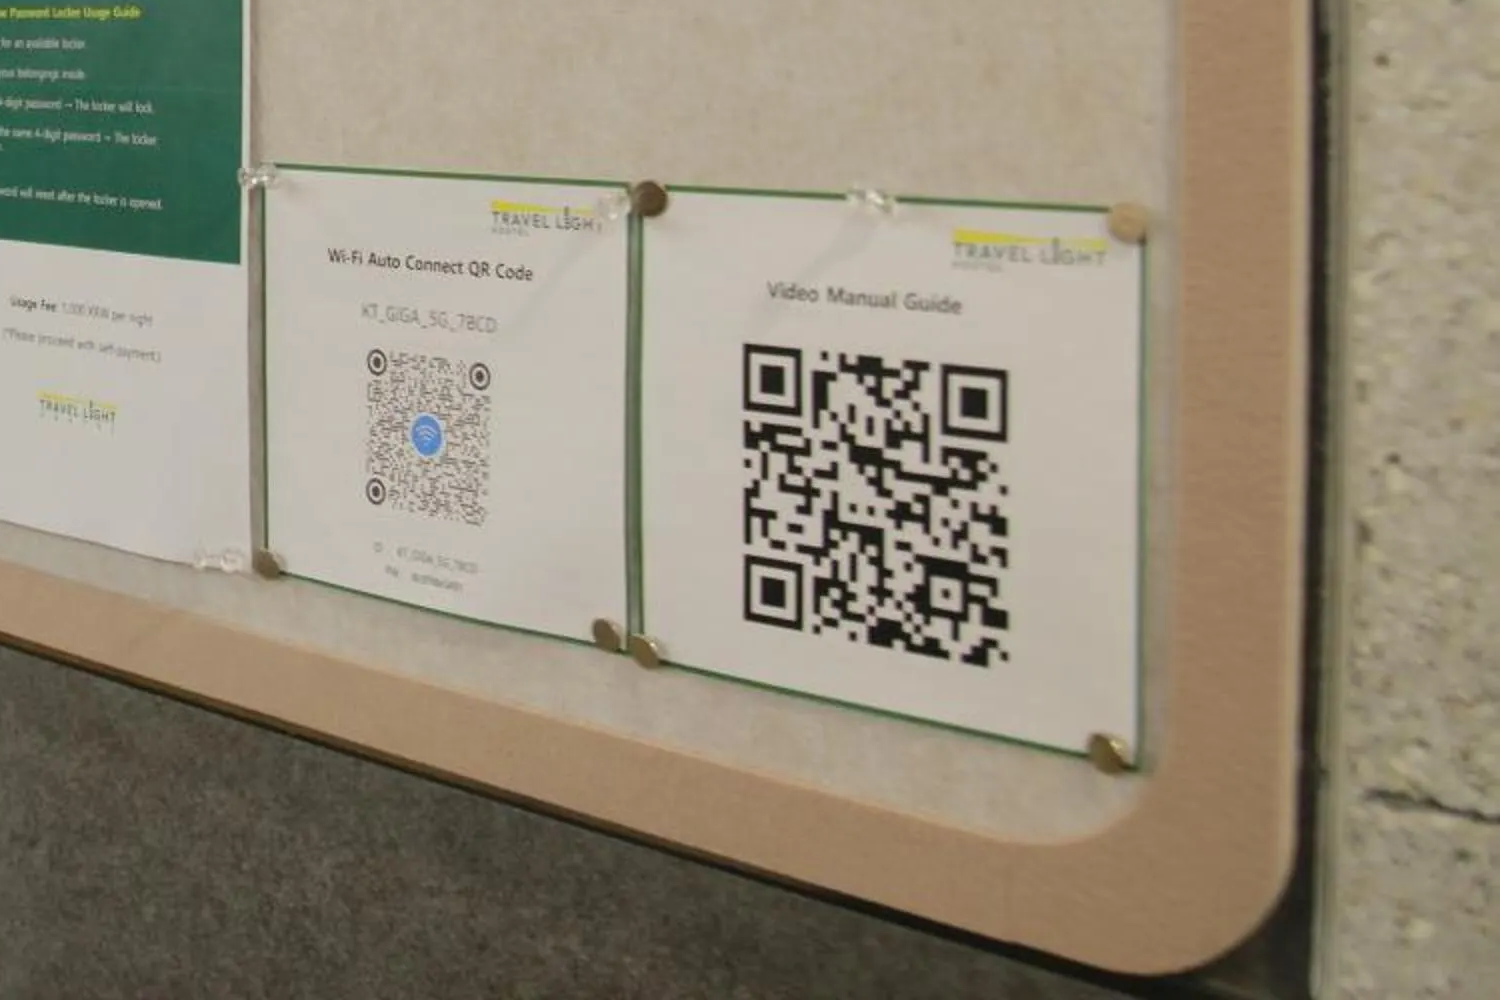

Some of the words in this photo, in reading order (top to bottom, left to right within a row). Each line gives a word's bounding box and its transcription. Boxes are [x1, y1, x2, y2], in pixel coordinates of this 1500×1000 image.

[492, 211, 551, 230] TRAVEL
[327, 247, 364, 268] Wi-Fi
[367, 252, 401, 271] Auto
[405, 255, 464, 276] Connect
[468, 260, 490, 279] QR
[495, 263, 534, 282] Code
[953, 242, 1033, 263] TRAVEL
[1039, 237, 1107, 267] LIGHT
[10, 296, 38, 311] Usage
[766, 280, 821, 305] Video
[826, 286, 898, 310] Manual
[903, 291, 964, 316] Guide
[40, 399, 79, 419] TRAVEL
[83, 400, 116, 424] LIGHT
